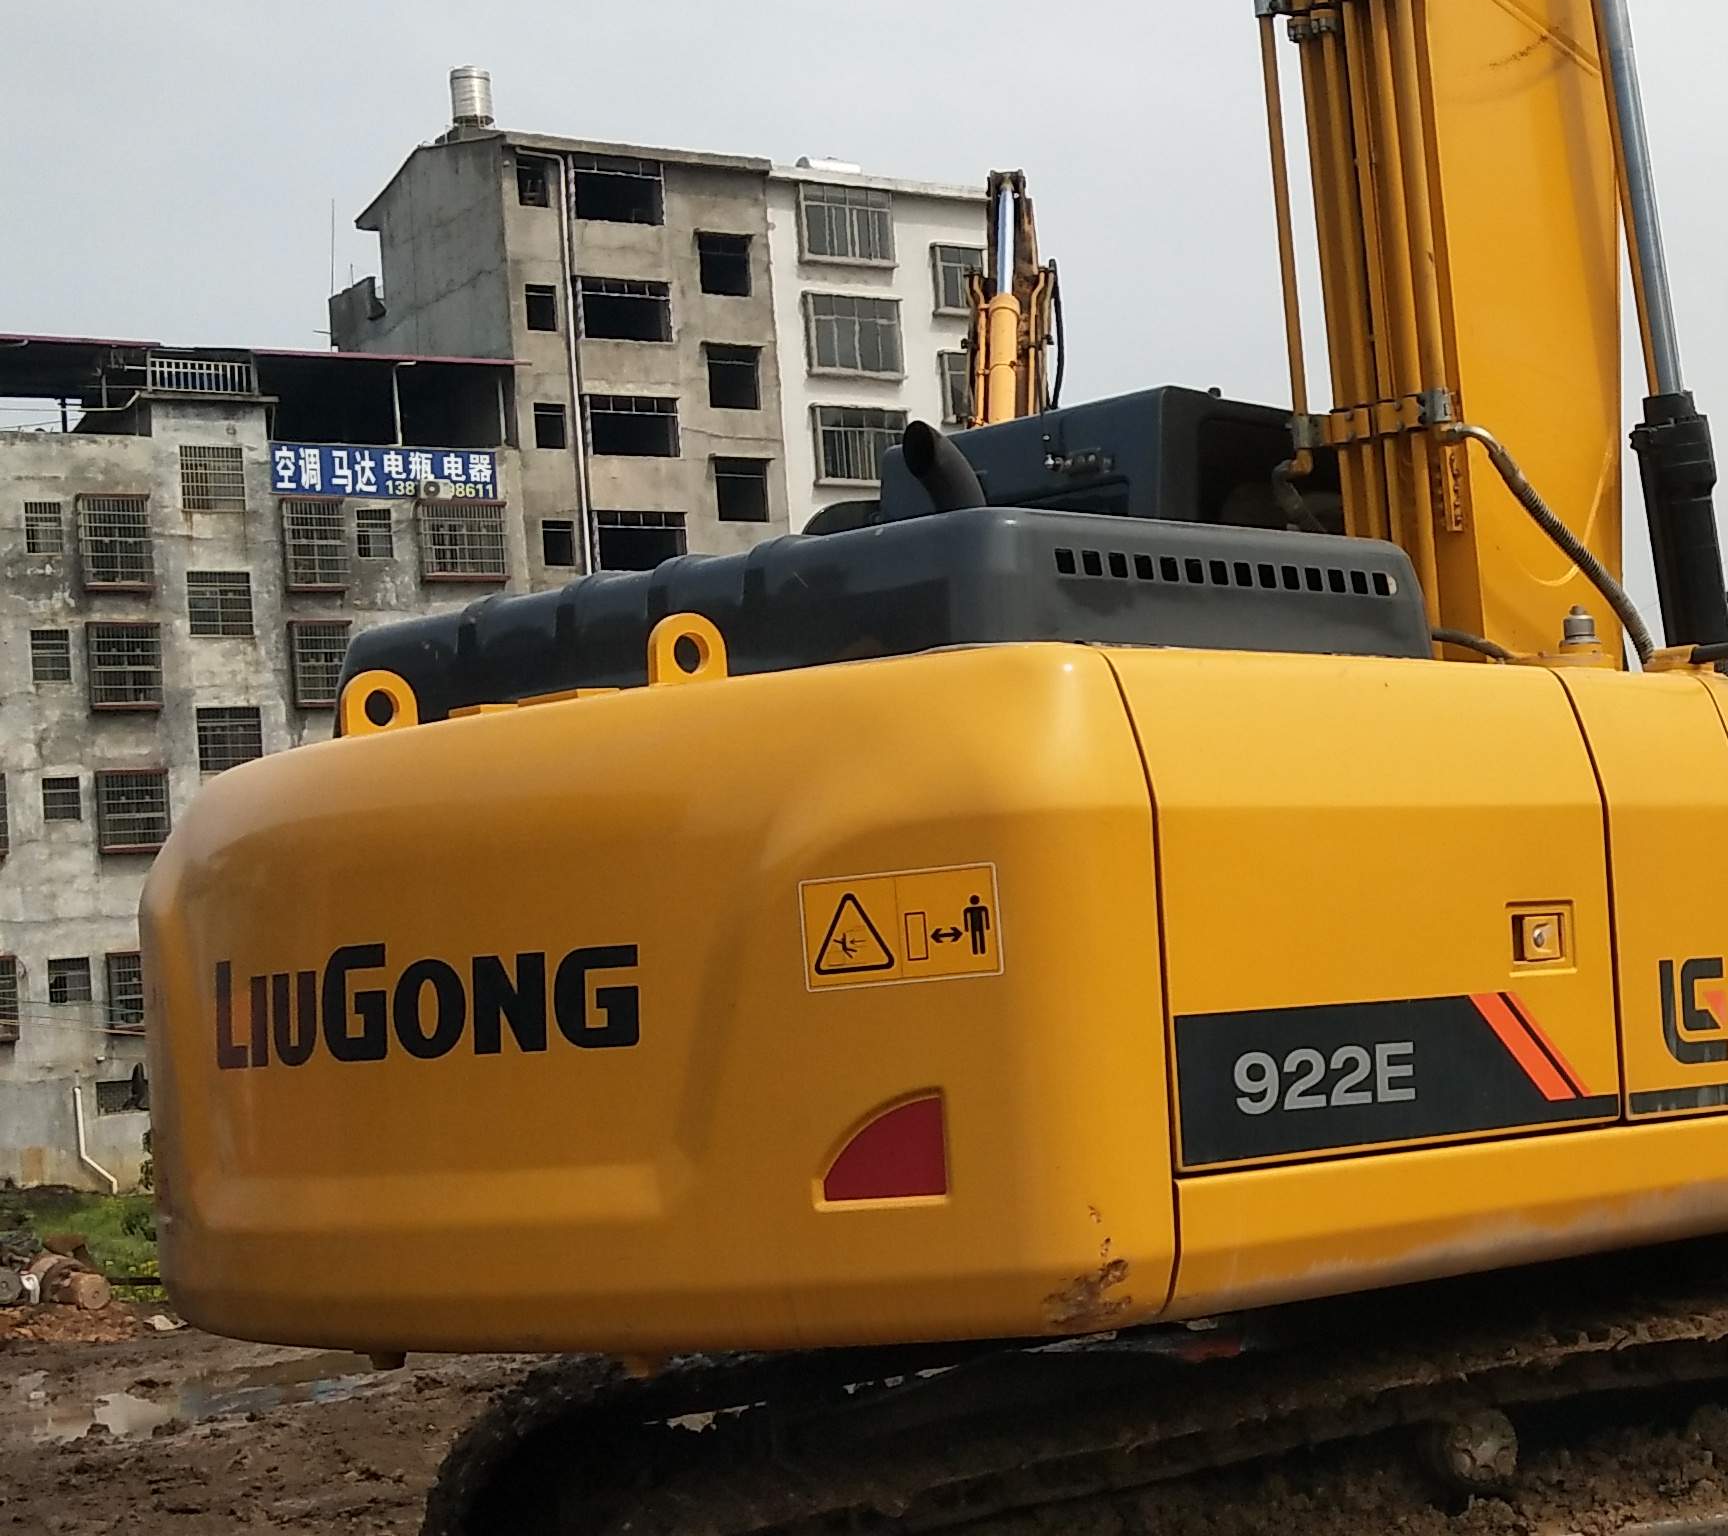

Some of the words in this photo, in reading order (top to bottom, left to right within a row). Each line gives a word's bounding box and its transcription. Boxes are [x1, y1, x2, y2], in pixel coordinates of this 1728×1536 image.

[274, 446, 322, 491] 空调
[331, 449, 377, 493] 马达
[383, 451, 434, 481] 电瓶
[443, 453, 493, 483] 电器
[216, 943, 640, 1069] LIUGONG
[1233, 1041, 1416, 1115] 922E
